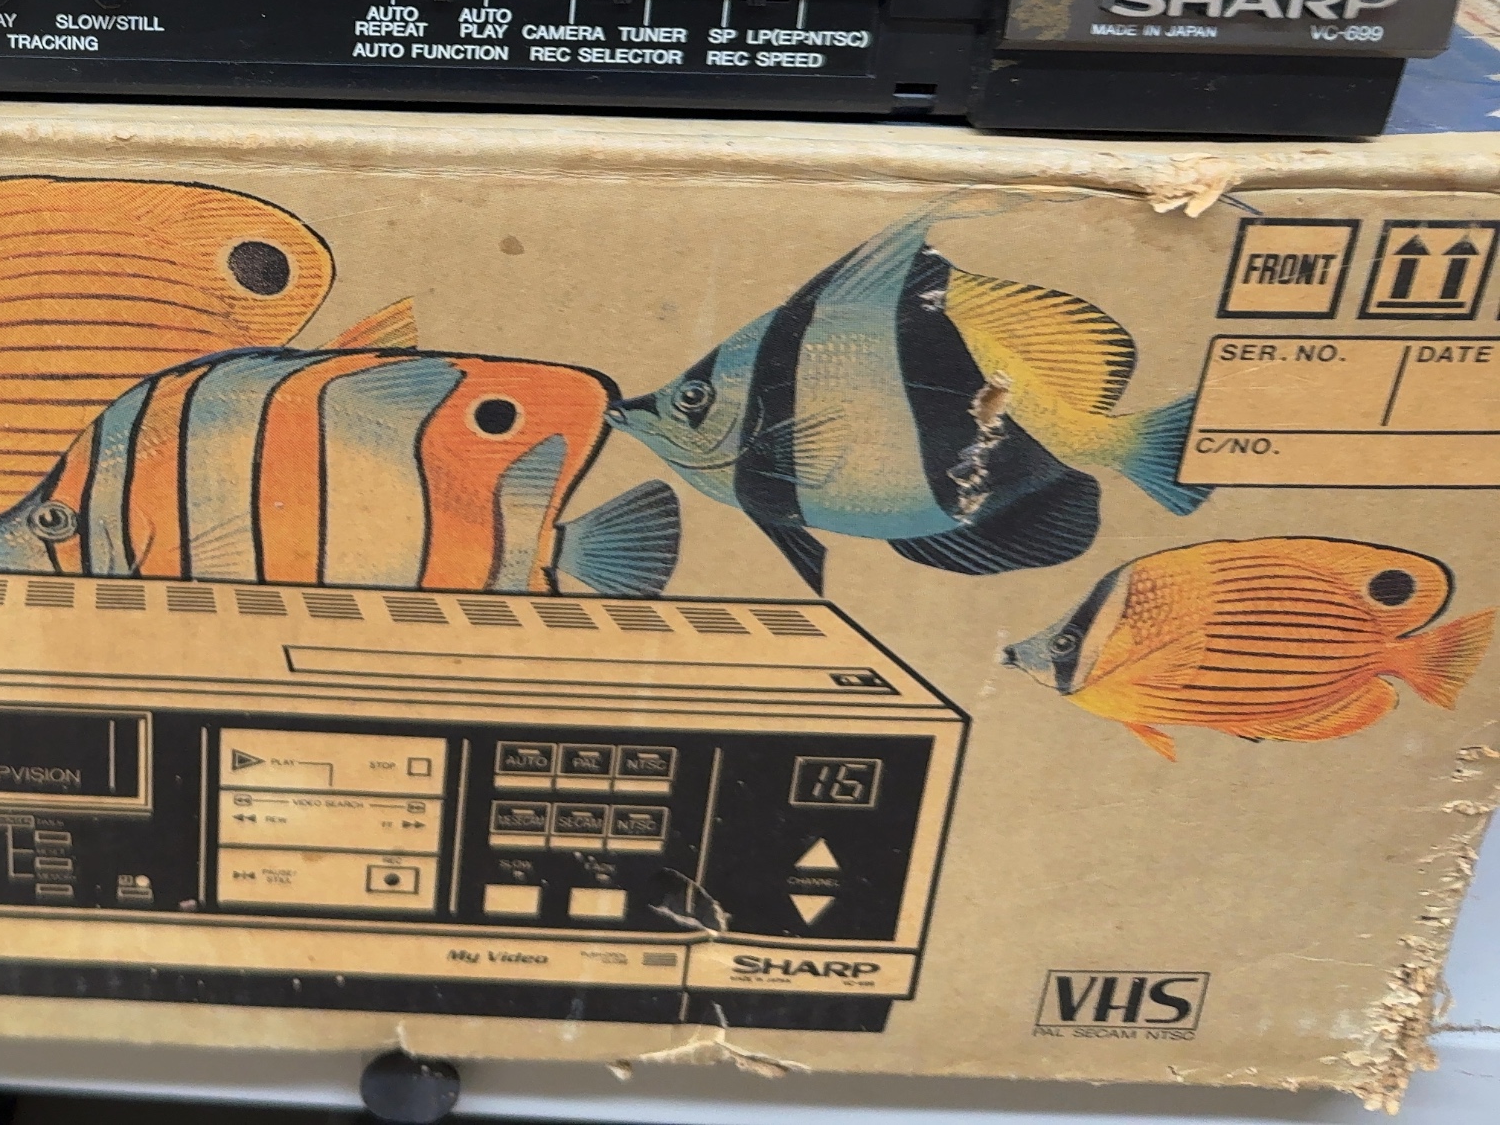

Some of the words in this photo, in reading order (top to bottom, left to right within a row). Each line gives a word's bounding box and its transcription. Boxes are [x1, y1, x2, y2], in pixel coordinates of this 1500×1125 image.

[55, 13, 165, 33] SLOW/STILL
[366, 5, 419, 22] AUTO
[458, 7, 513, 24] AUTO
[355, 22, 428, 38] REPEAT
[459, 24, 509, 40] PLAY
[521, 24, 605, 42] CAMERA
[618, 27, 688, 44] TUNER
[708, 28, 738, 45] SP
[1090, 22, 1137, 37] MADE
[1142, 23, 1161, 37] IN
[1165, 24, 1218, 39] JAPAN
[1309, 24, 1384, 43] VC-699
[6, 32, 99, 52] TRACKING
[352, 42, 405, 59] AUTO
[411, 43, 509, 61] FUNCTION
[529, 46, 573, 64] REC
[578, 47, 684, 66] SELECTOR
[706, 50, 750, 67] REC
[755, 51, 826, 68] SPEED
[1242, 253, 1337, 285] FRONT
[1220, 343, 1287, 362] SER.
[1295, 344, 1347, 363] NO.
[1416, 345, 1494, 364] DATE
[1195, 436, 1280, 456] C/NO.
[505, 755, 548, 768] AUTO
[571, 757, 601, 769] PAL
[626, 758, 668, 771] NTSC
[811, 762, 868, 801] 16
[448, 949, 481, 964] My
[487, 950, 549, 965] Video
[731, 954, 882, 979] SHARP
[1055, 976, 1200, 1024] VHS
[1032, 1026, 1064, 1038] PAL
[1072, 1027, 1138, 1040] SECAM
[1145, 1029, 1196, 1042] NTSC
